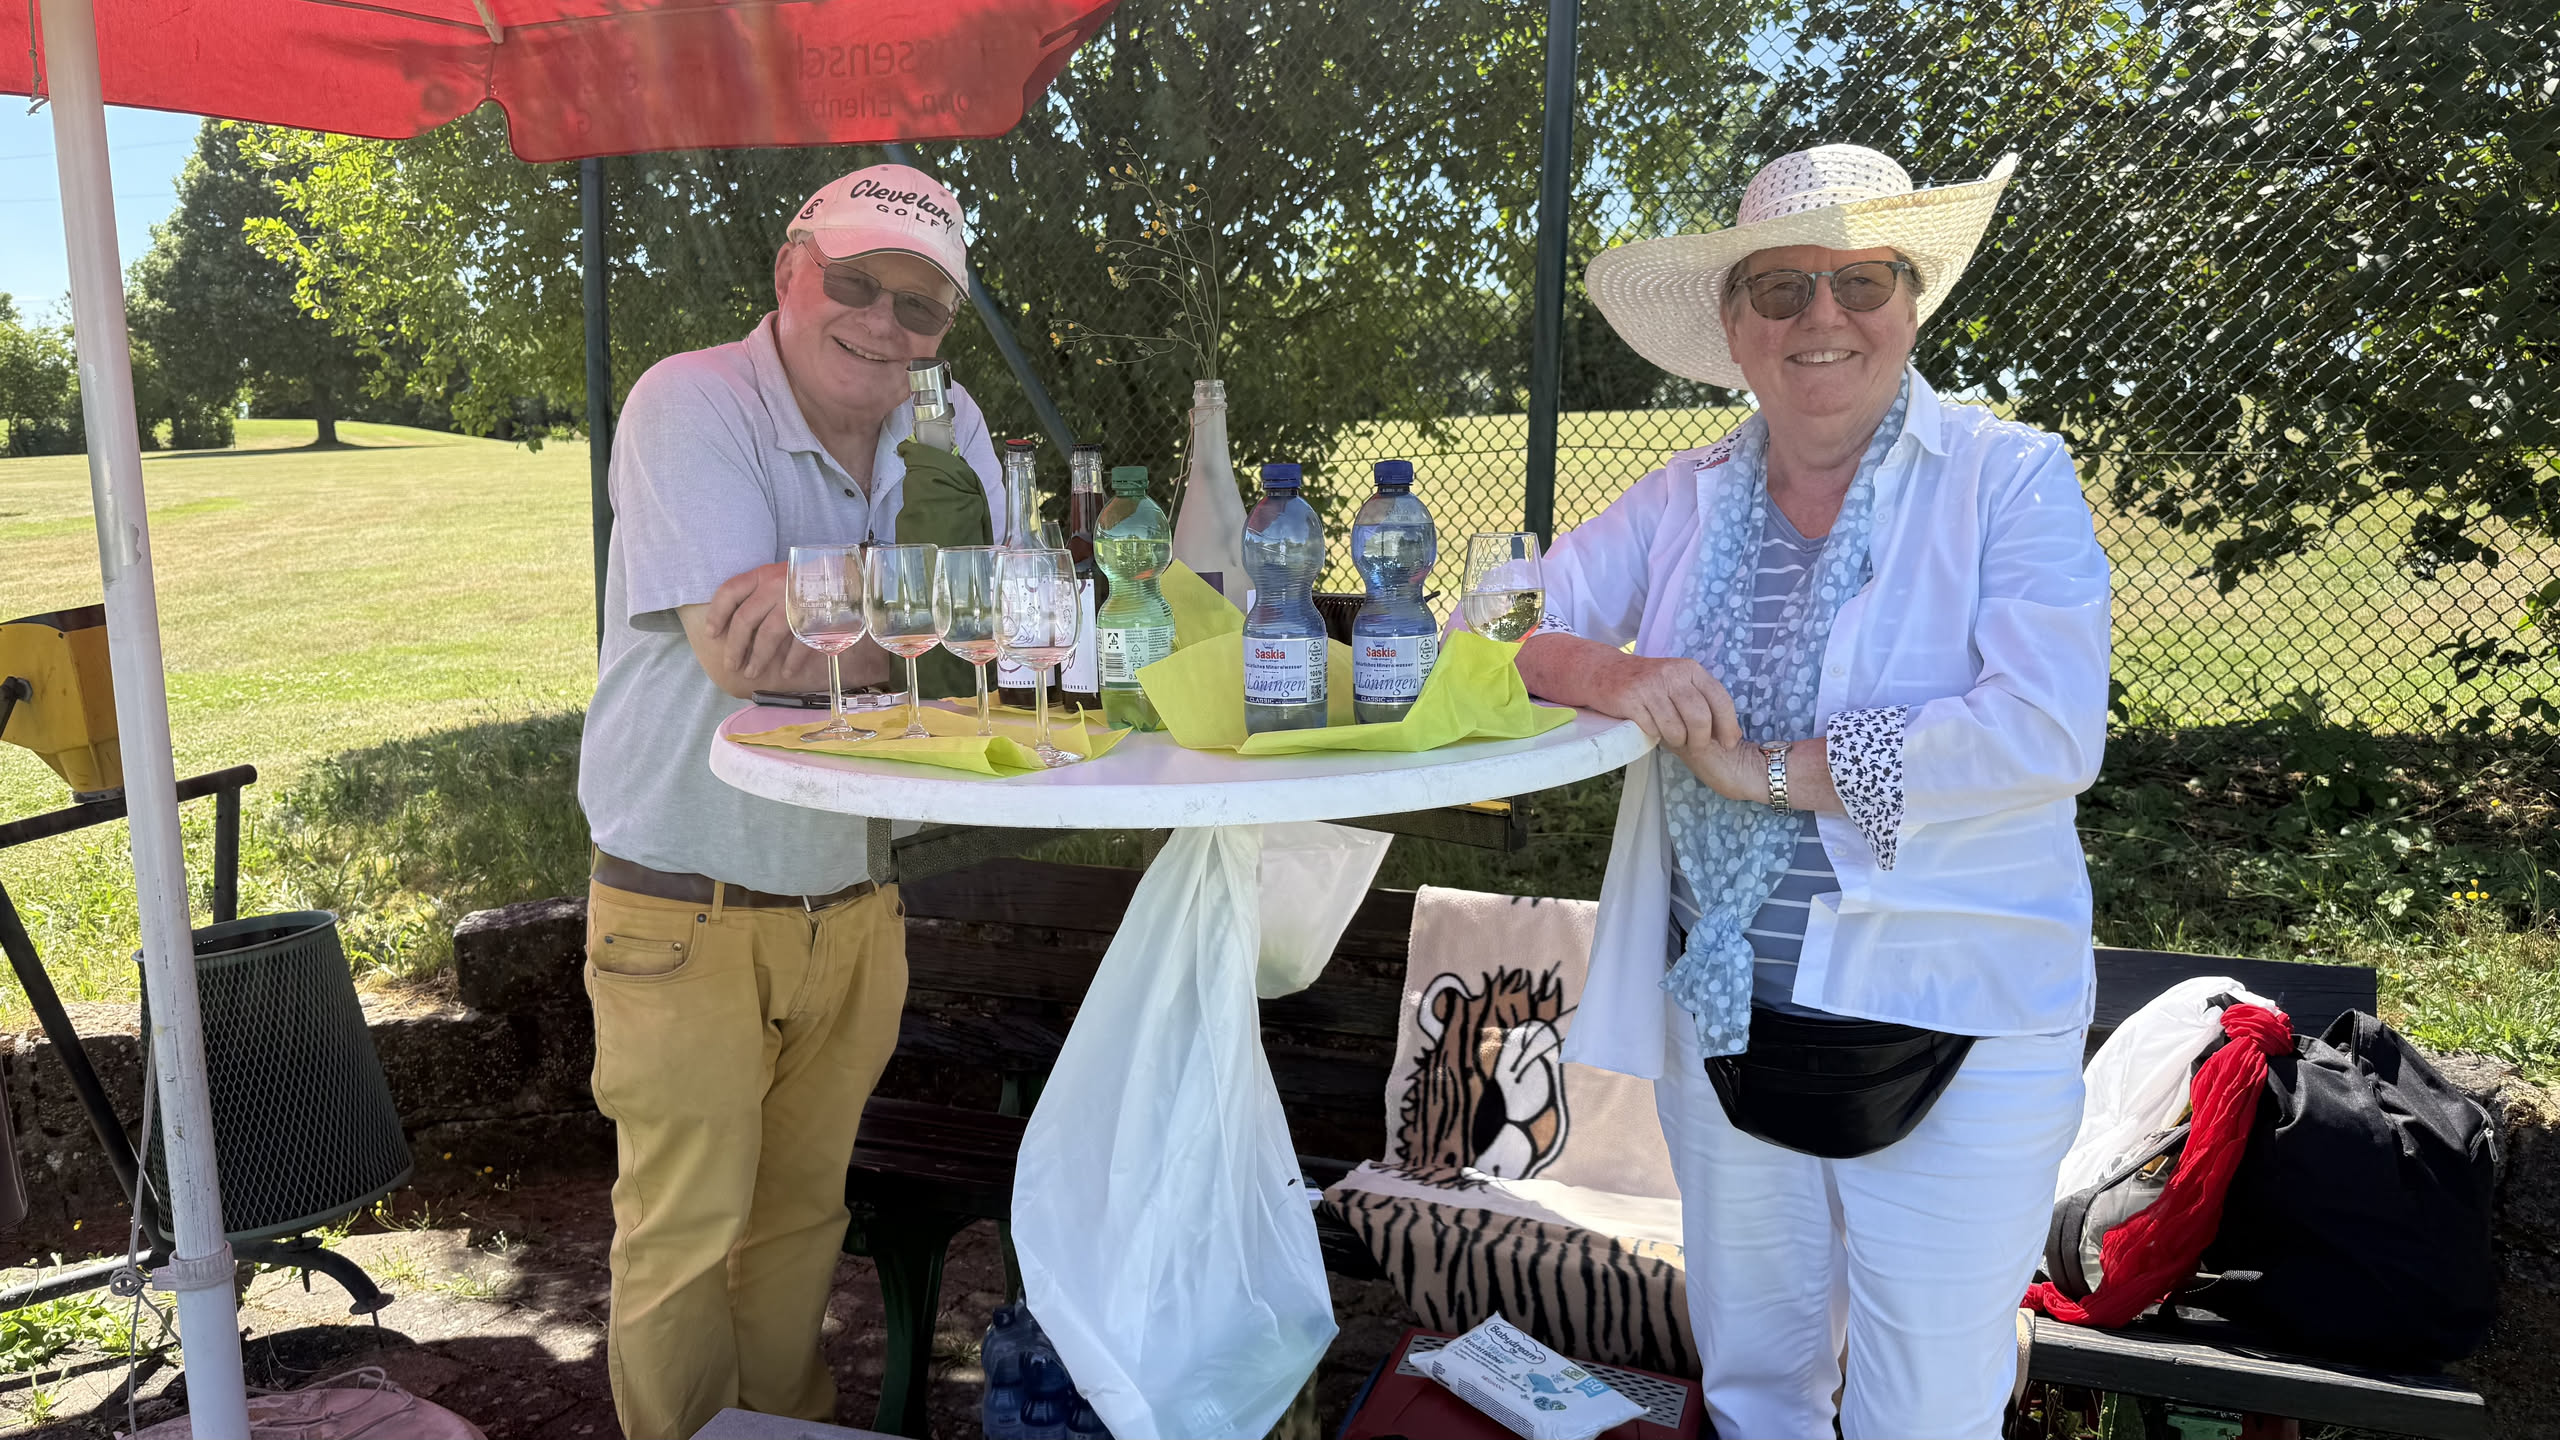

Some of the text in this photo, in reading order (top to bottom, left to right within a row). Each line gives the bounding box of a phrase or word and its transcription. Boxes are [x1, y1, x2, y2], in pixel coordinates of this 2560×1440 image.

[850, 179, 955, 234] Cleveland
[876, 204, 941, 228] GOLF
[1255, 648, 1286, 660] Saskia
[1366, 646, 1397, 658] Saskia
[1249, 697, 1275, 705] CLASSIC
[1360, 695, 1386, 703] CLASSIC
[1489, 1325, 1538, 1361] Babydream
[1583, 1378, 1605, 1392] 60
